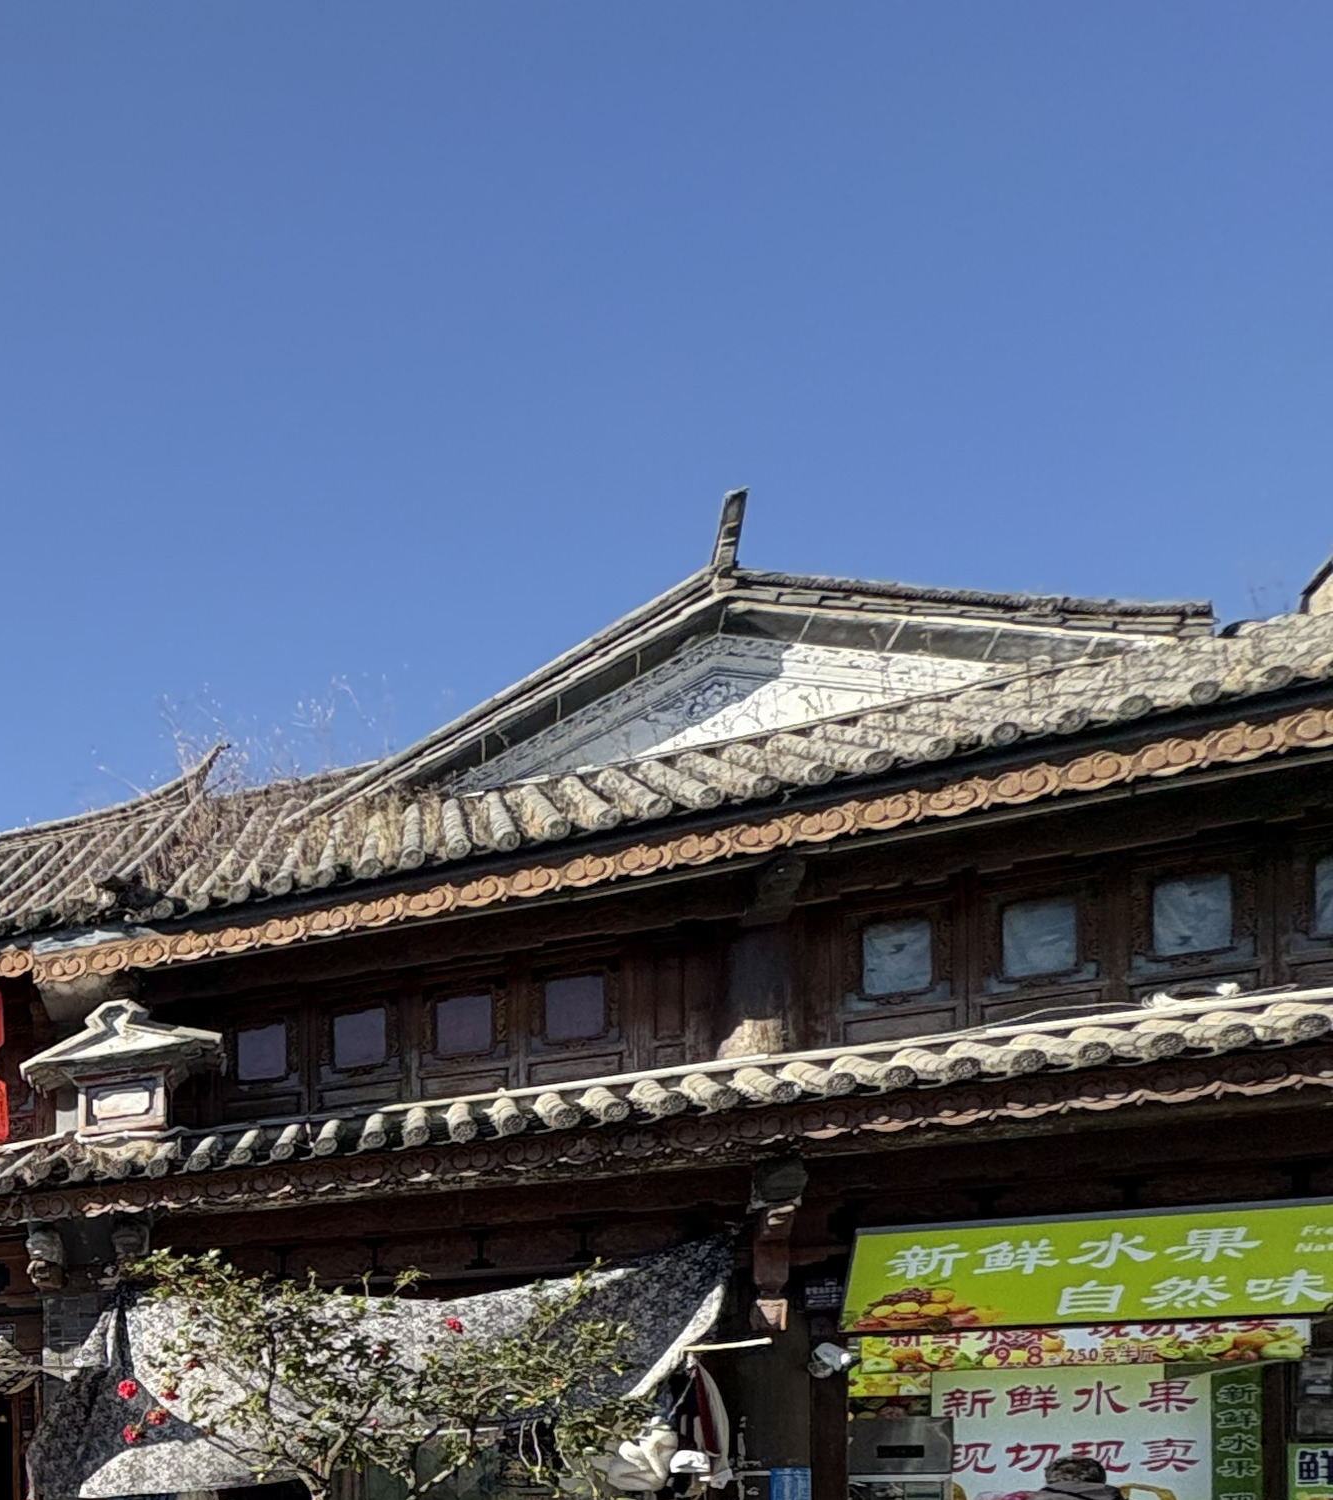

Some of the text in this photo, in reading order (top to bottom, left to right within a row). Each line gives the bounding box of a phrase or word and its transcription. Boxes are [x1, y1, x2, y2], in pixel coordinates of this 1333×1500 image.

[886, 1226, 1262, 1280] 新鲜水果
[1056, 1269, 1333, 1316] 自然味
[942, 1380, 1200, 1418] 新鲜水果
[1216, 1383, 1261, 1478] 新鲜水果
[952, 1437, 1200, 1474] 现切现卖
